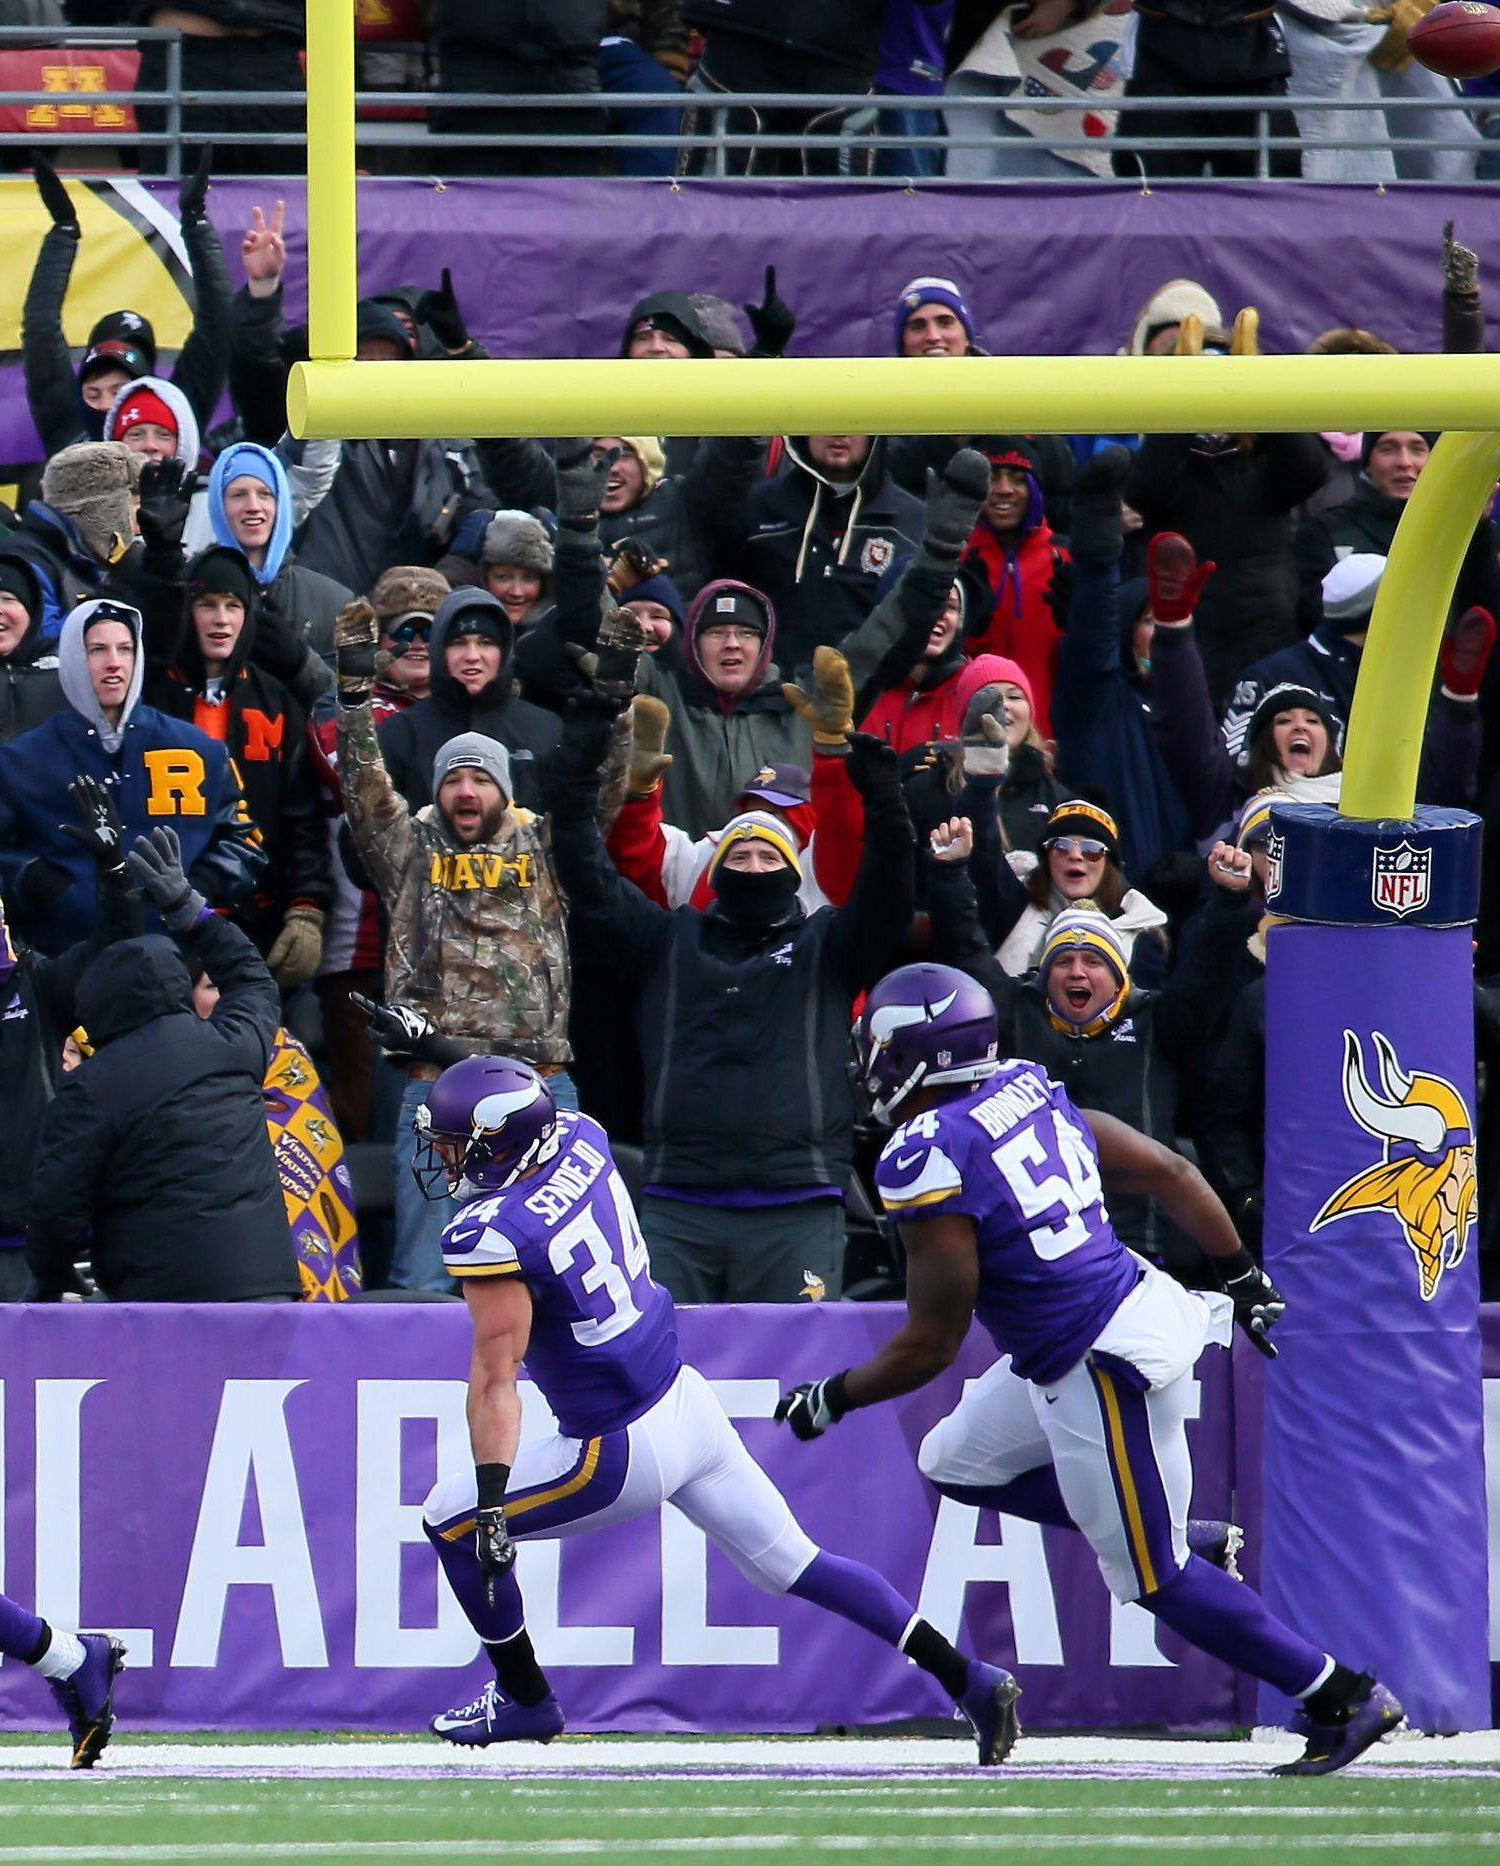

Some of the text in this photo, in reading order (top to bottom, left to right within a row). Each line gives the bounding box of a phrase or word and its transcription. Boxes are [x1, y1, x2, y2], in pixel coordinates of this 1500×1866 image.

[144, 748, 206, 816] R
[430, 852, 533, 890] NAVY
[1380, 875, 1423, 906] NFL
[524, 1138, 606, 1227] SENDEJO
[990, 1109, 1110, 1262] 54
[548, 1168, 657, 1347] 34
